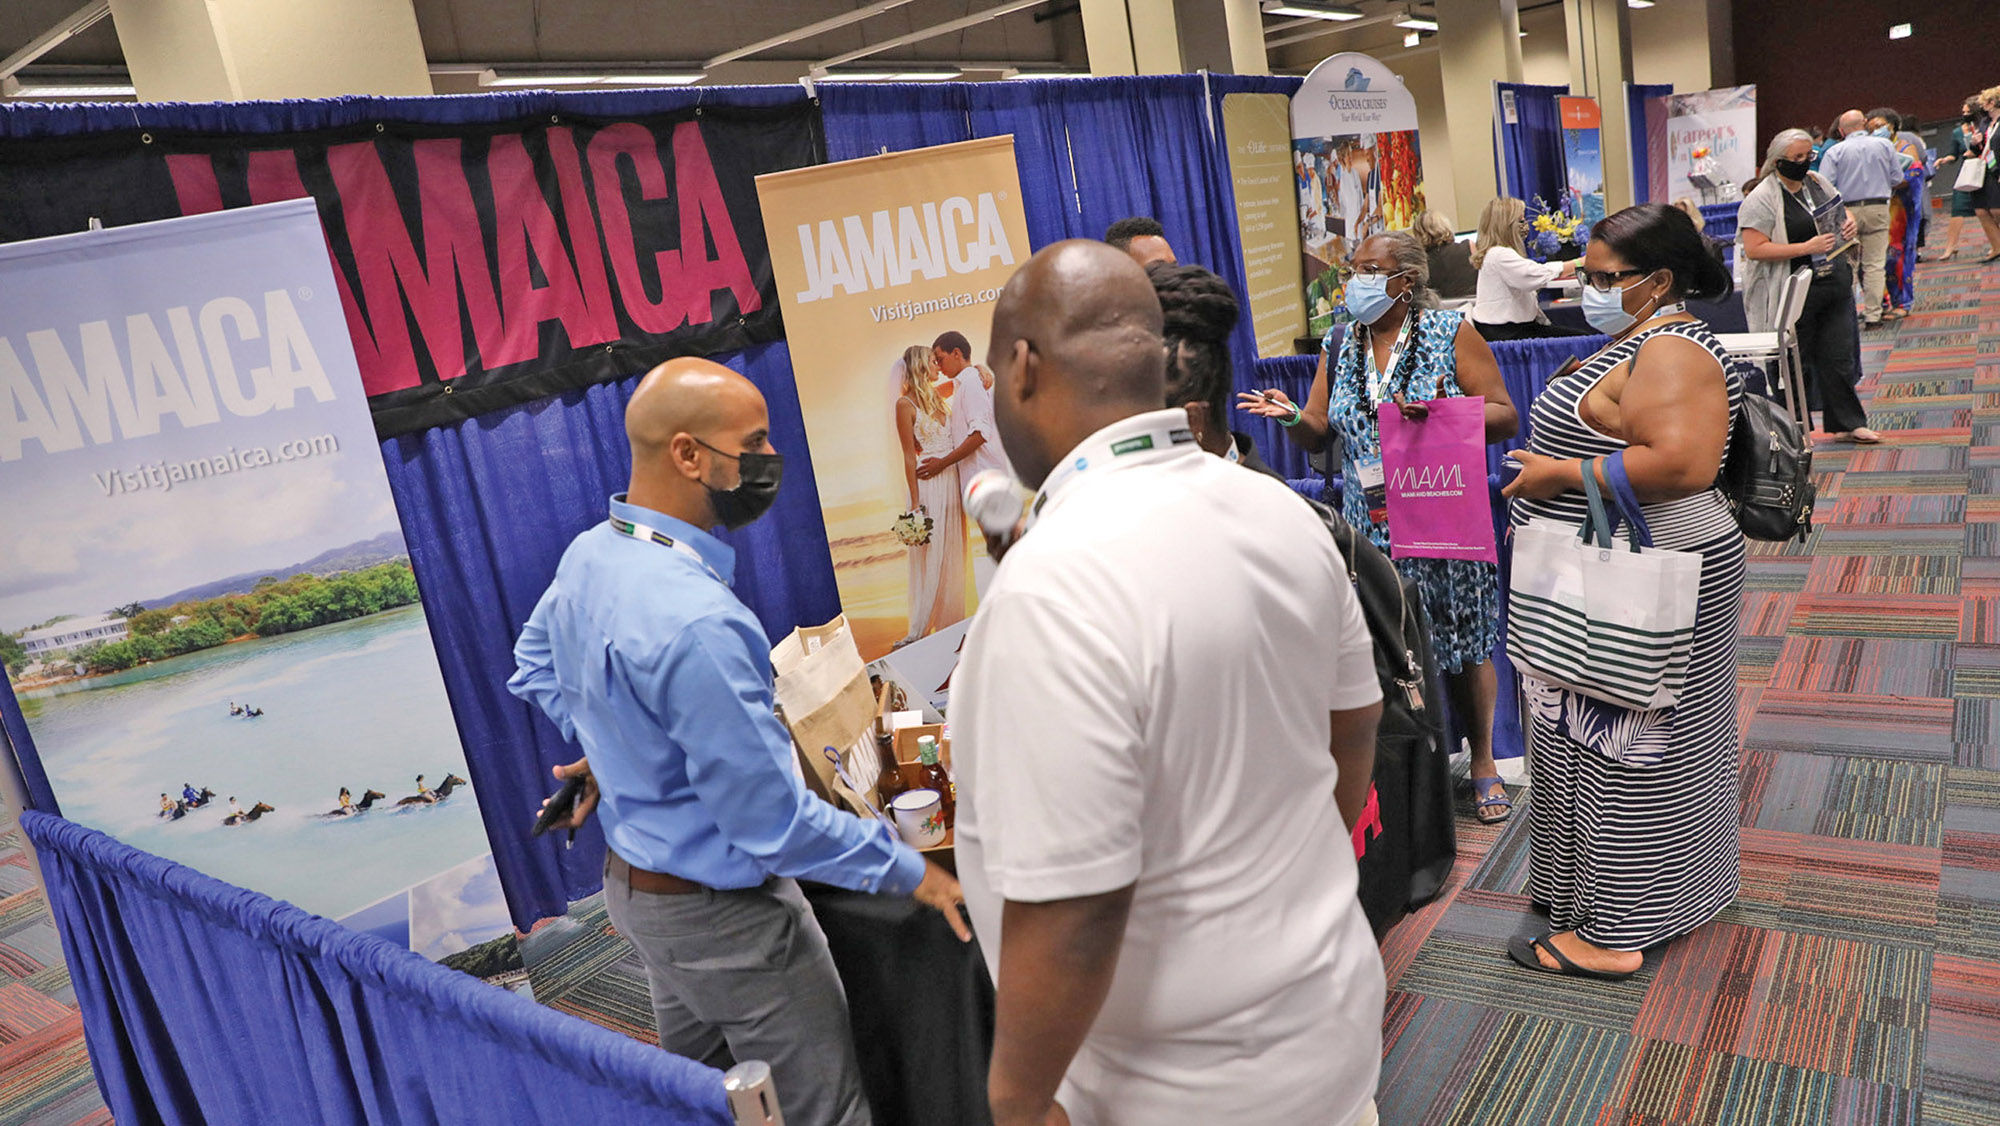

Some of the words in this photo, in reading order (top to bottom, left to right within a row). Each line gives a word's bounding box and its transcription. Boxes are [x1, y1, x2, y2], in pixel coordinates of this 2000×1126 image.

[1328, 94, 1361, 110] OCEANIA
[1362, 98, 1387, 109] CRUISES
[165, 121, 762, 397] MAICA
[797, 192, 1015, 304] JAMAICA
[93, 432, 340, 497] Visitjamaica.com
[1390, 464, 1463, 490] MIAMI
